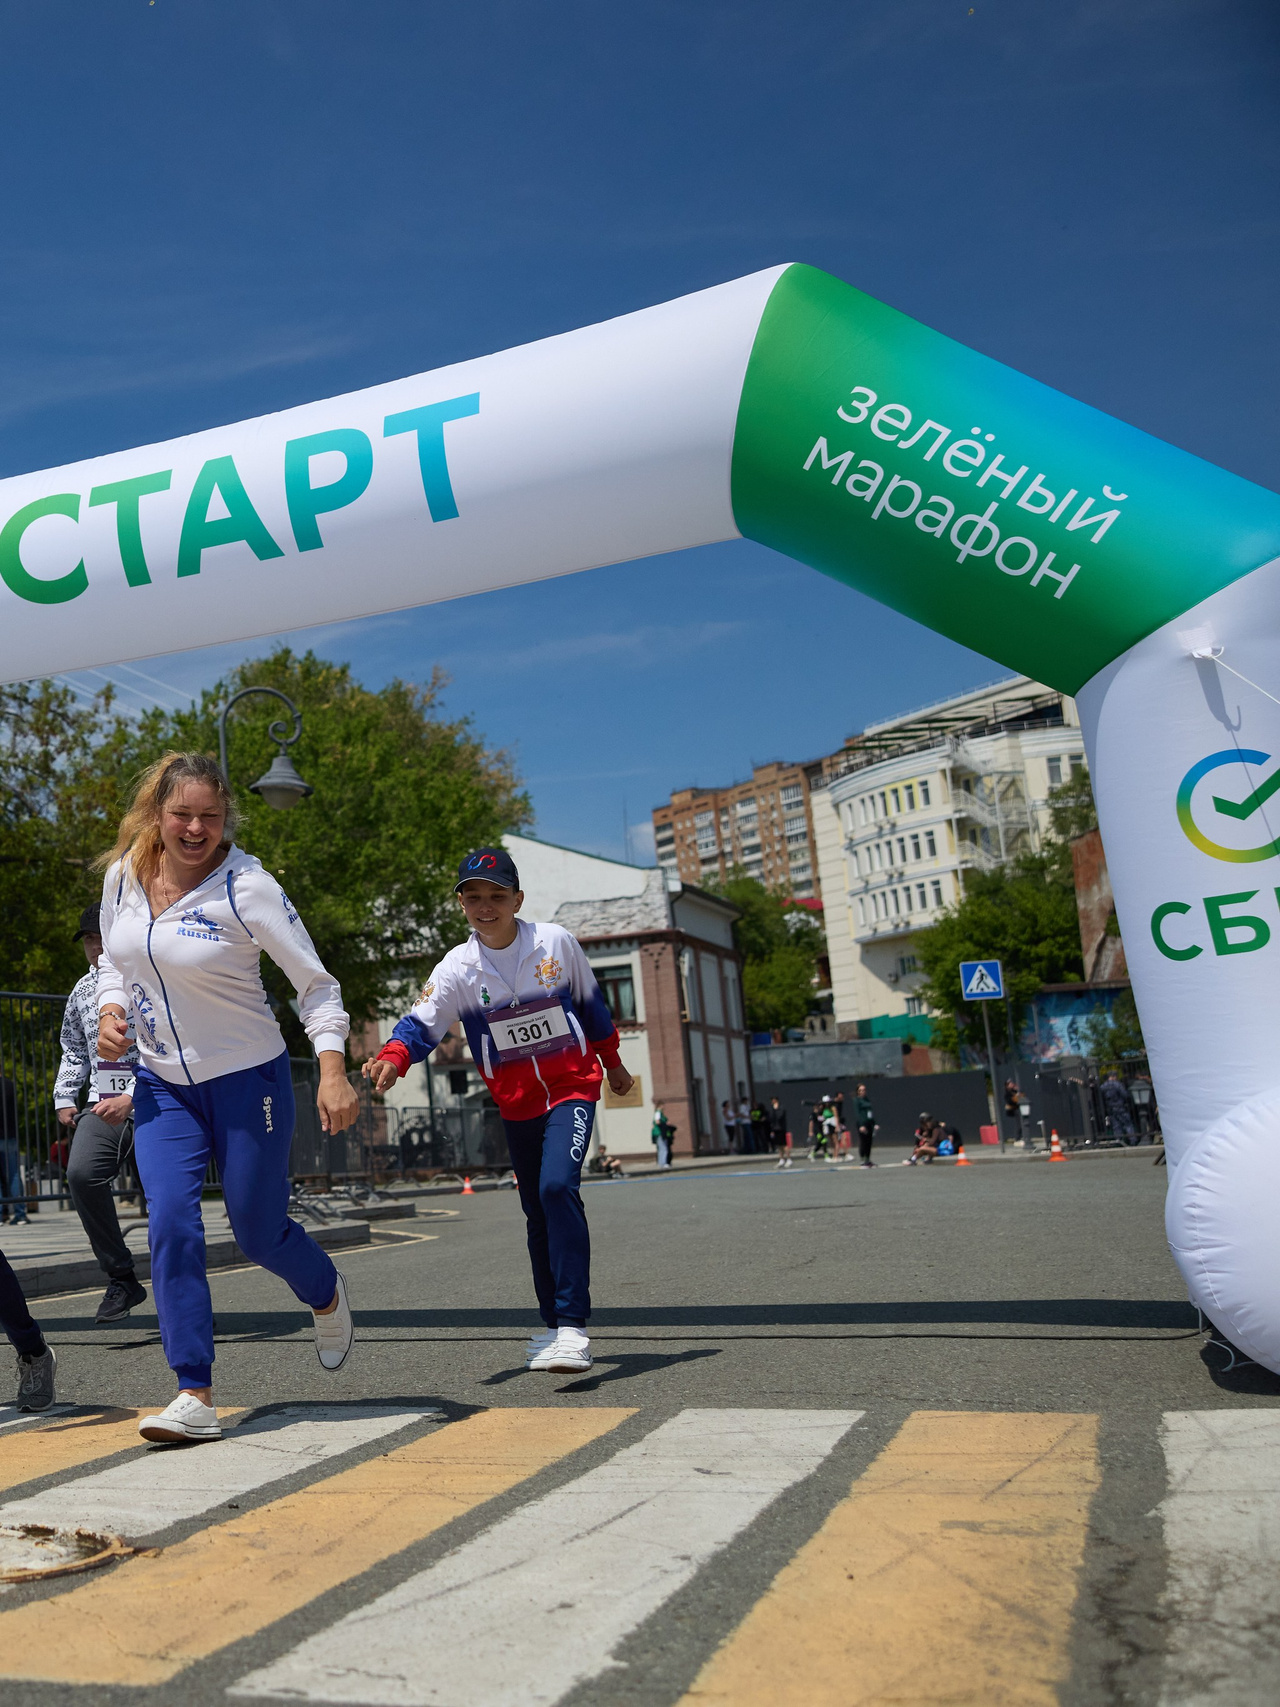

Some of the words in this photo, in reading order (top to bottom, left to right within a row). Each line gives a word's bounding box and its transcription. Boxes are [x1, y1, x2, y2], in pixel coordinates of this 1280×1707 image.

[836, 386, 1129, 545] зелёный
[802, 435, 1082, 600] марафон
[176, 926, 220, 942] Russia
[1150, 886, 1280, 962] СБ
[507, 1019, 553, 1045] 1301
[110, 1077, 132, 1091] 13
[262, 1096, 274, 1134] Sport
[570, 1106, 588, 1162] САМБО
